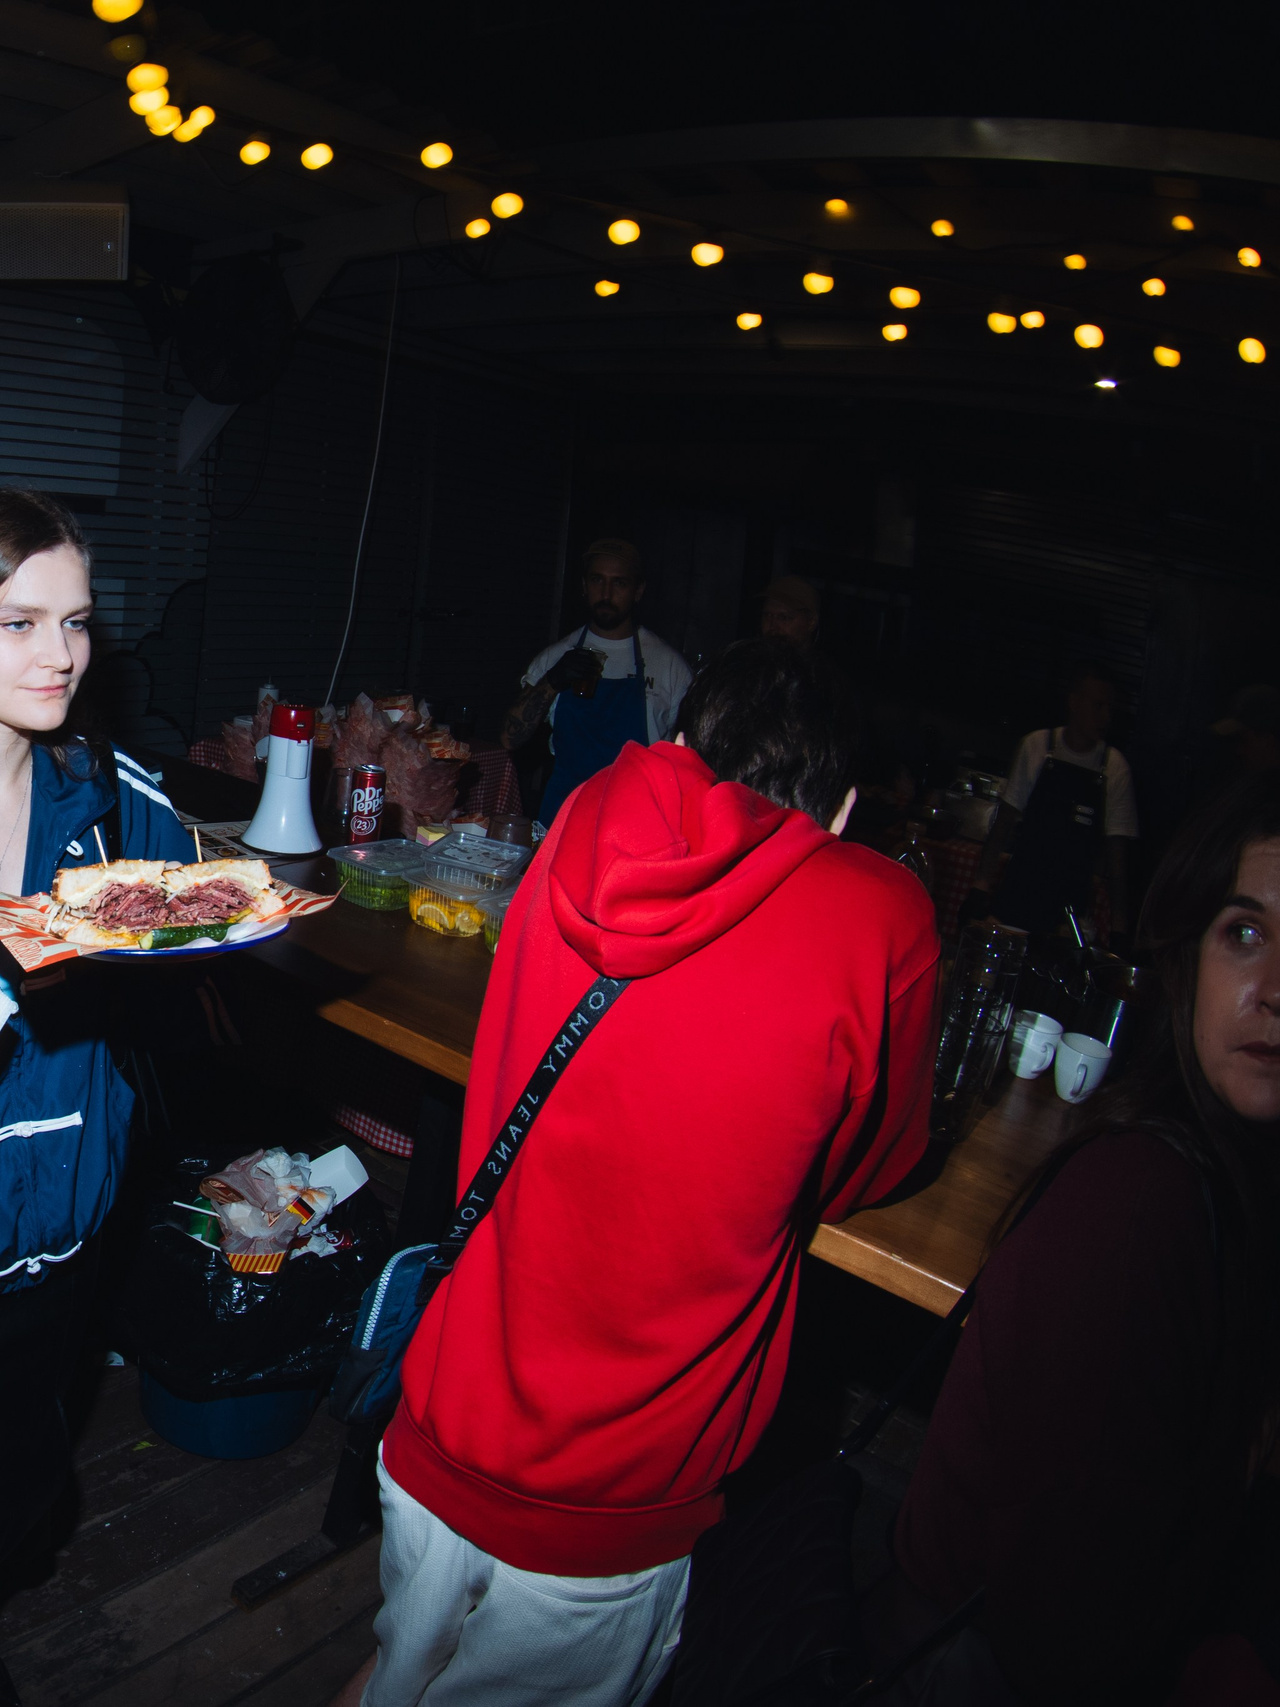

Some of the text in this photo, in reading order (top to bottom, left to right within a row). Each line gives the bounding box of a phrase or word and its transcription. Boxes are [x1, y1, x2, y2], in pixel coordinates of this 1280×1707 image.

[365, 787, 382, 801] Dr
[351, 788, 384, 815] Peppe
[357, 820, 367, 830] 23
